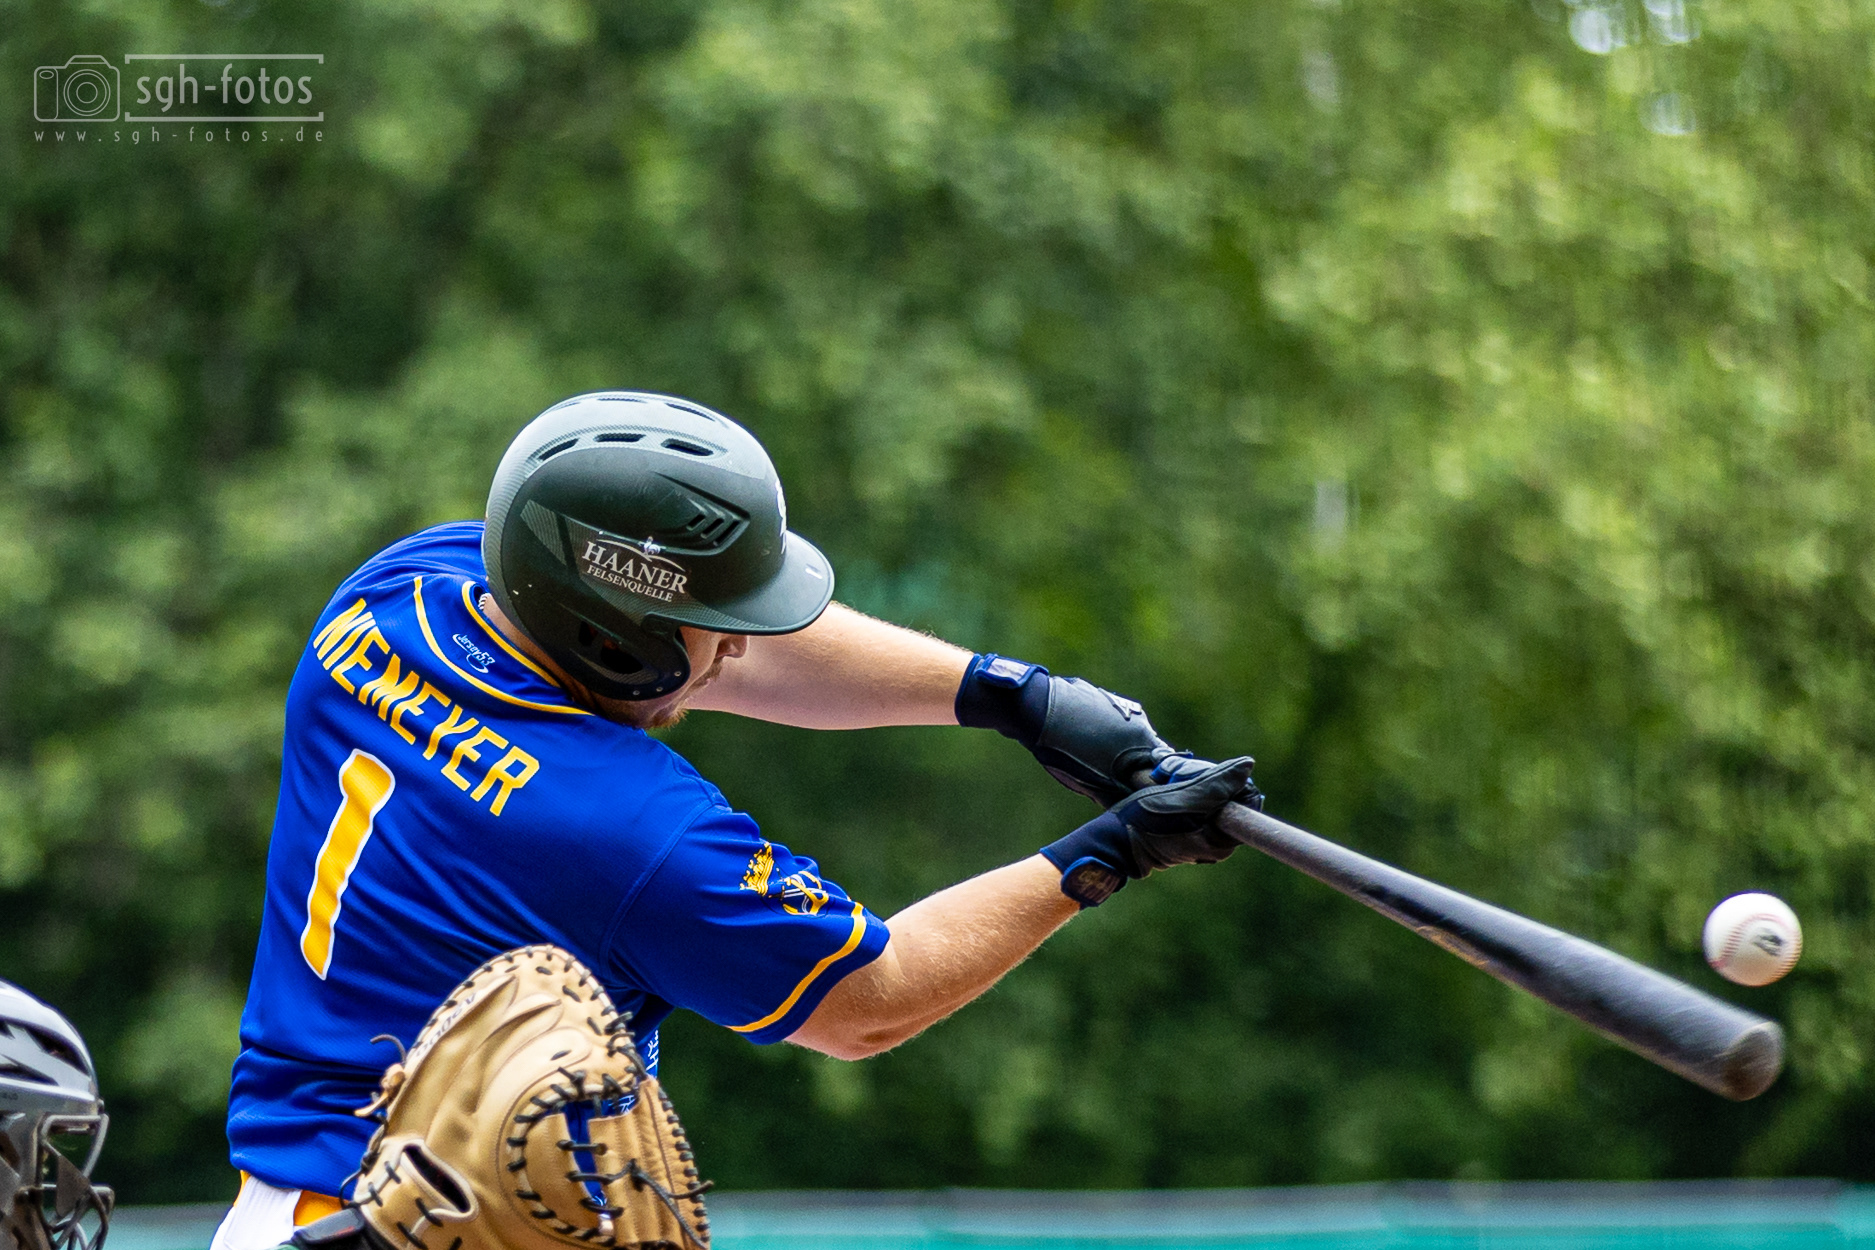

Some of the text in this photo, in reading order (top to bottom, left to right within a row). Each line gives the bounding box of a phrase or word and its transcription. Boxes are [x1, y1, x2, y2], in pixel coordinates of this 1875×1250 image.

[582, 541, 688, 594] HAANER
[587, 564, 674, 603] FELSENQUELLE
[312, 598, 540, 817] NIEMEYER
[300, 748, 395, 980] 1
